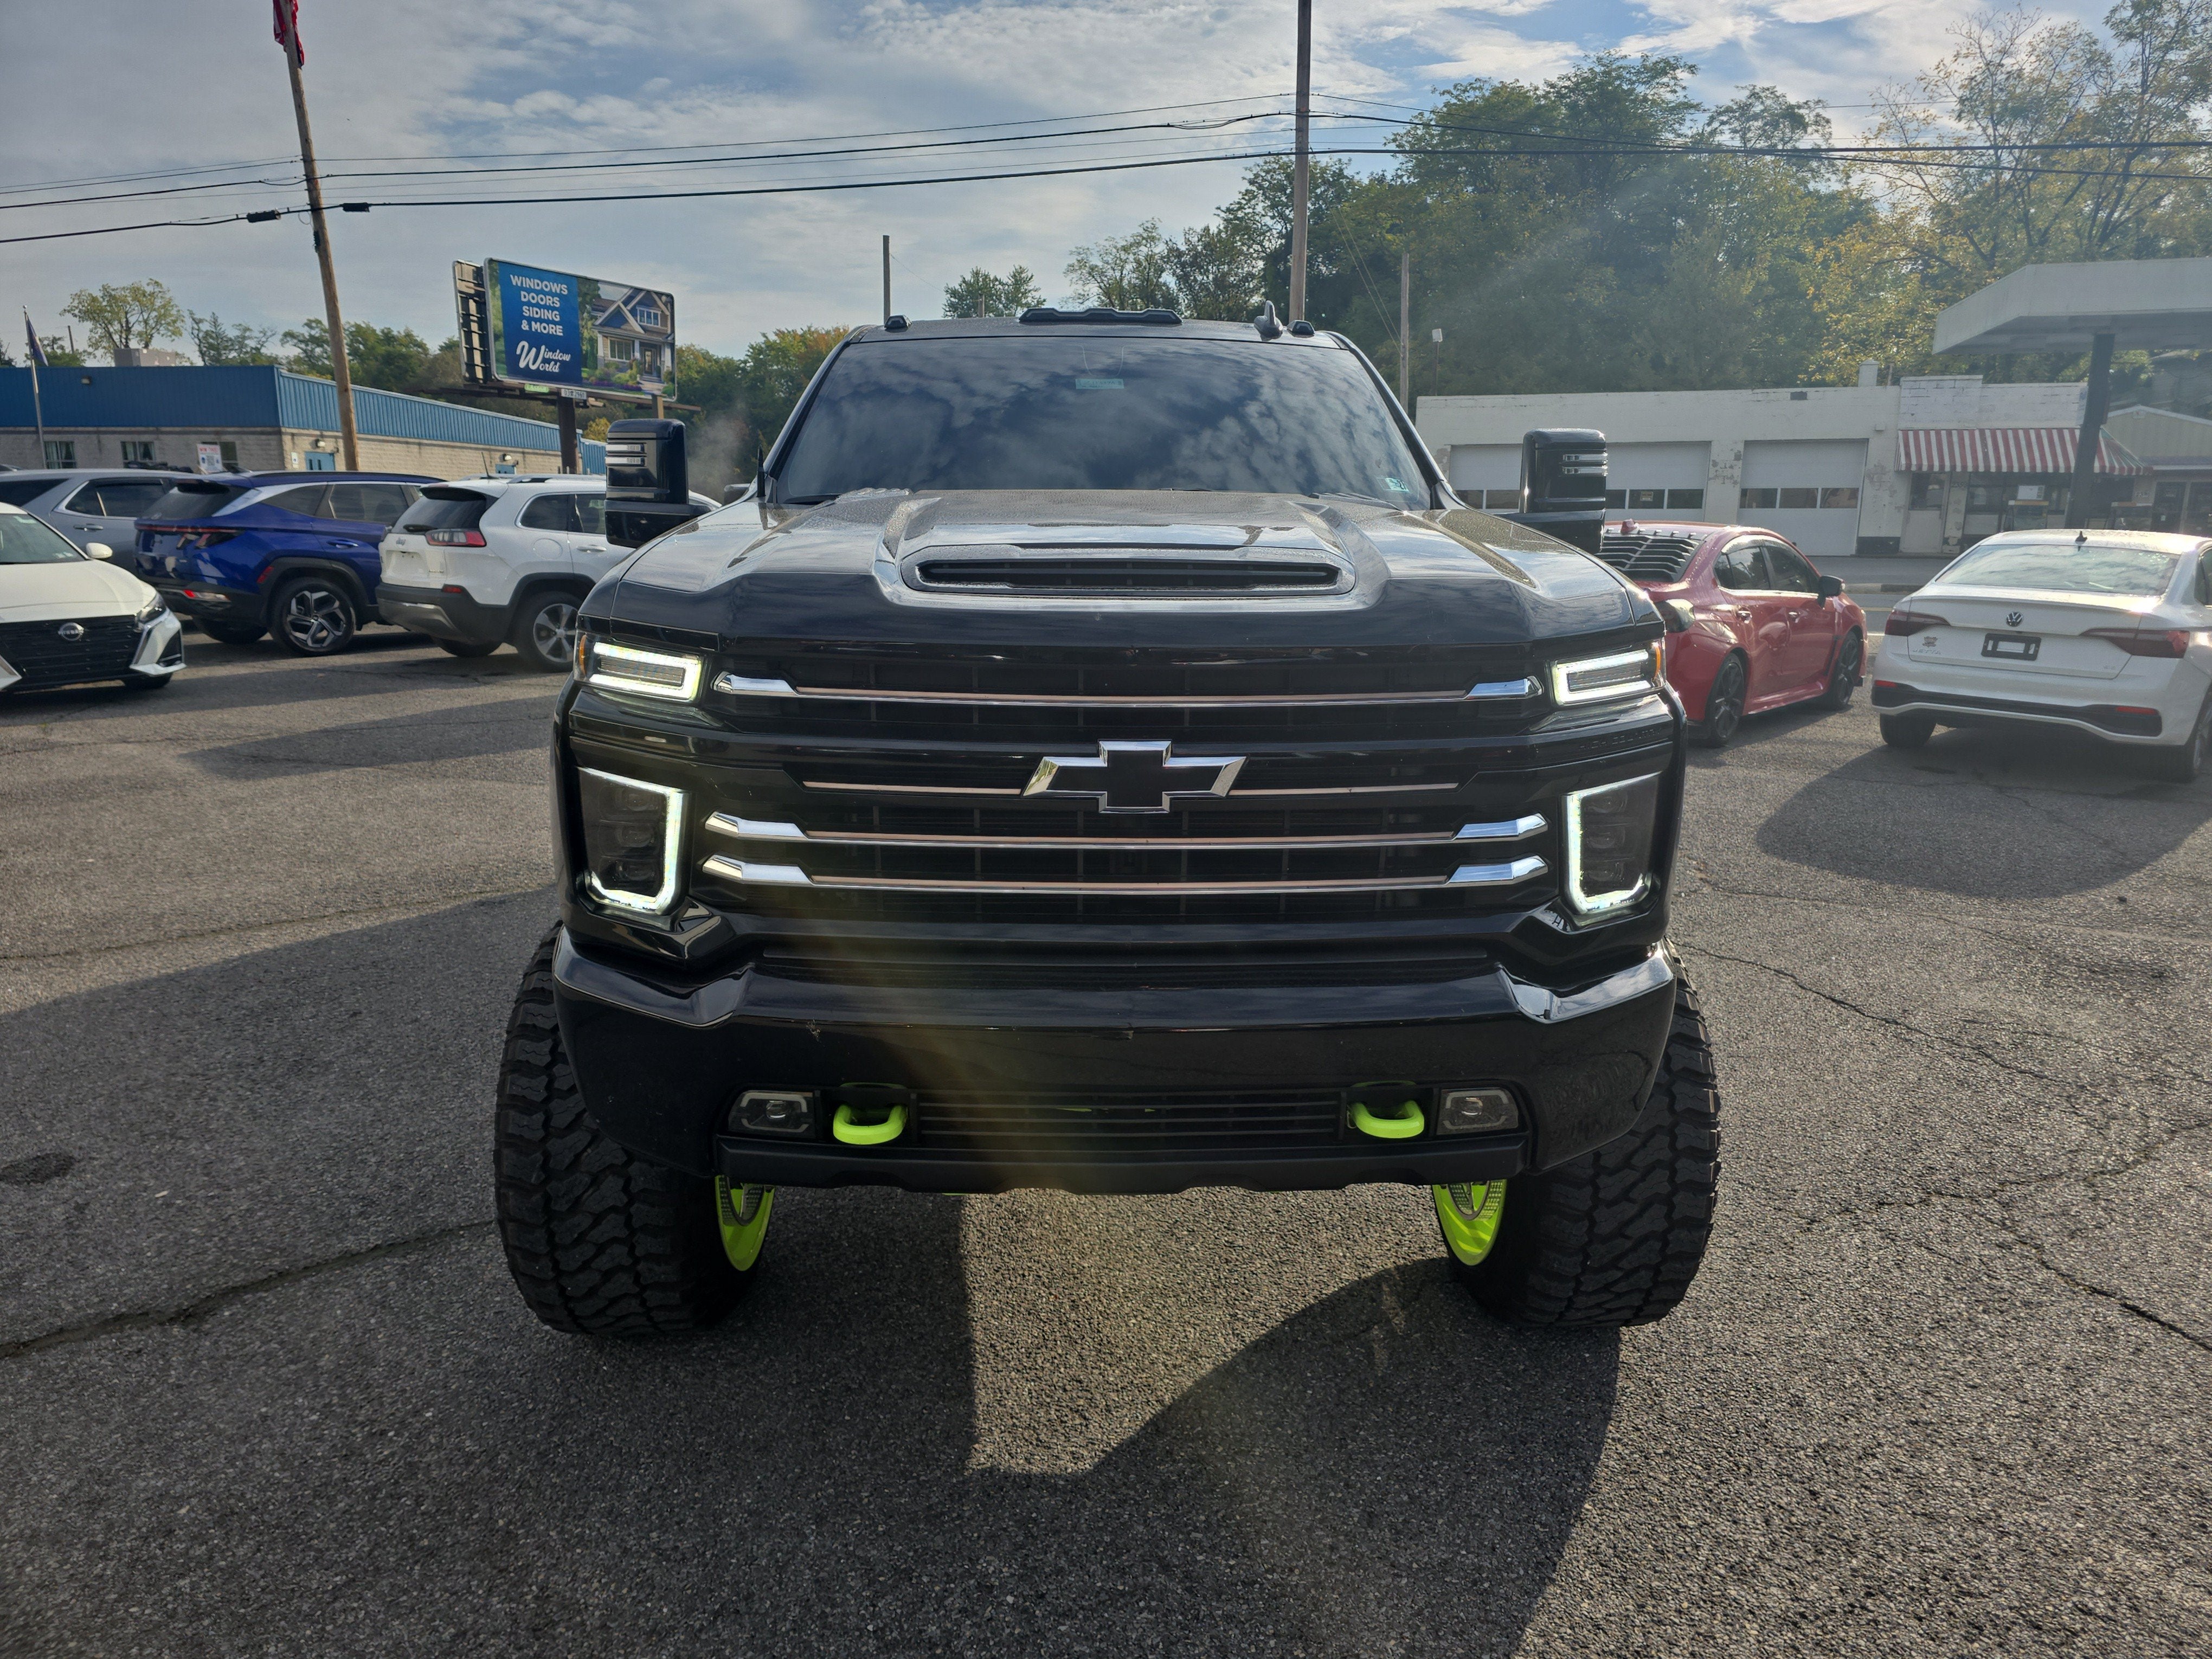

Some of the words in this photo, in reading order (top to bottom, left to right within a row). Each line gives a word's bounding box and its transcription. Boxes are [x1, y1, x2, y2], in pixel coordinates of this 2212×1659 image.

[510, 274, 568, 294] WINDOWS
[520, 291, 560, 307] DOORS
[522, 305, 560, 321] SIDING
[521, 319, 529, 331] &
[531, 321, 563, 336] MORE
[516, 340, 571, 370] Window
